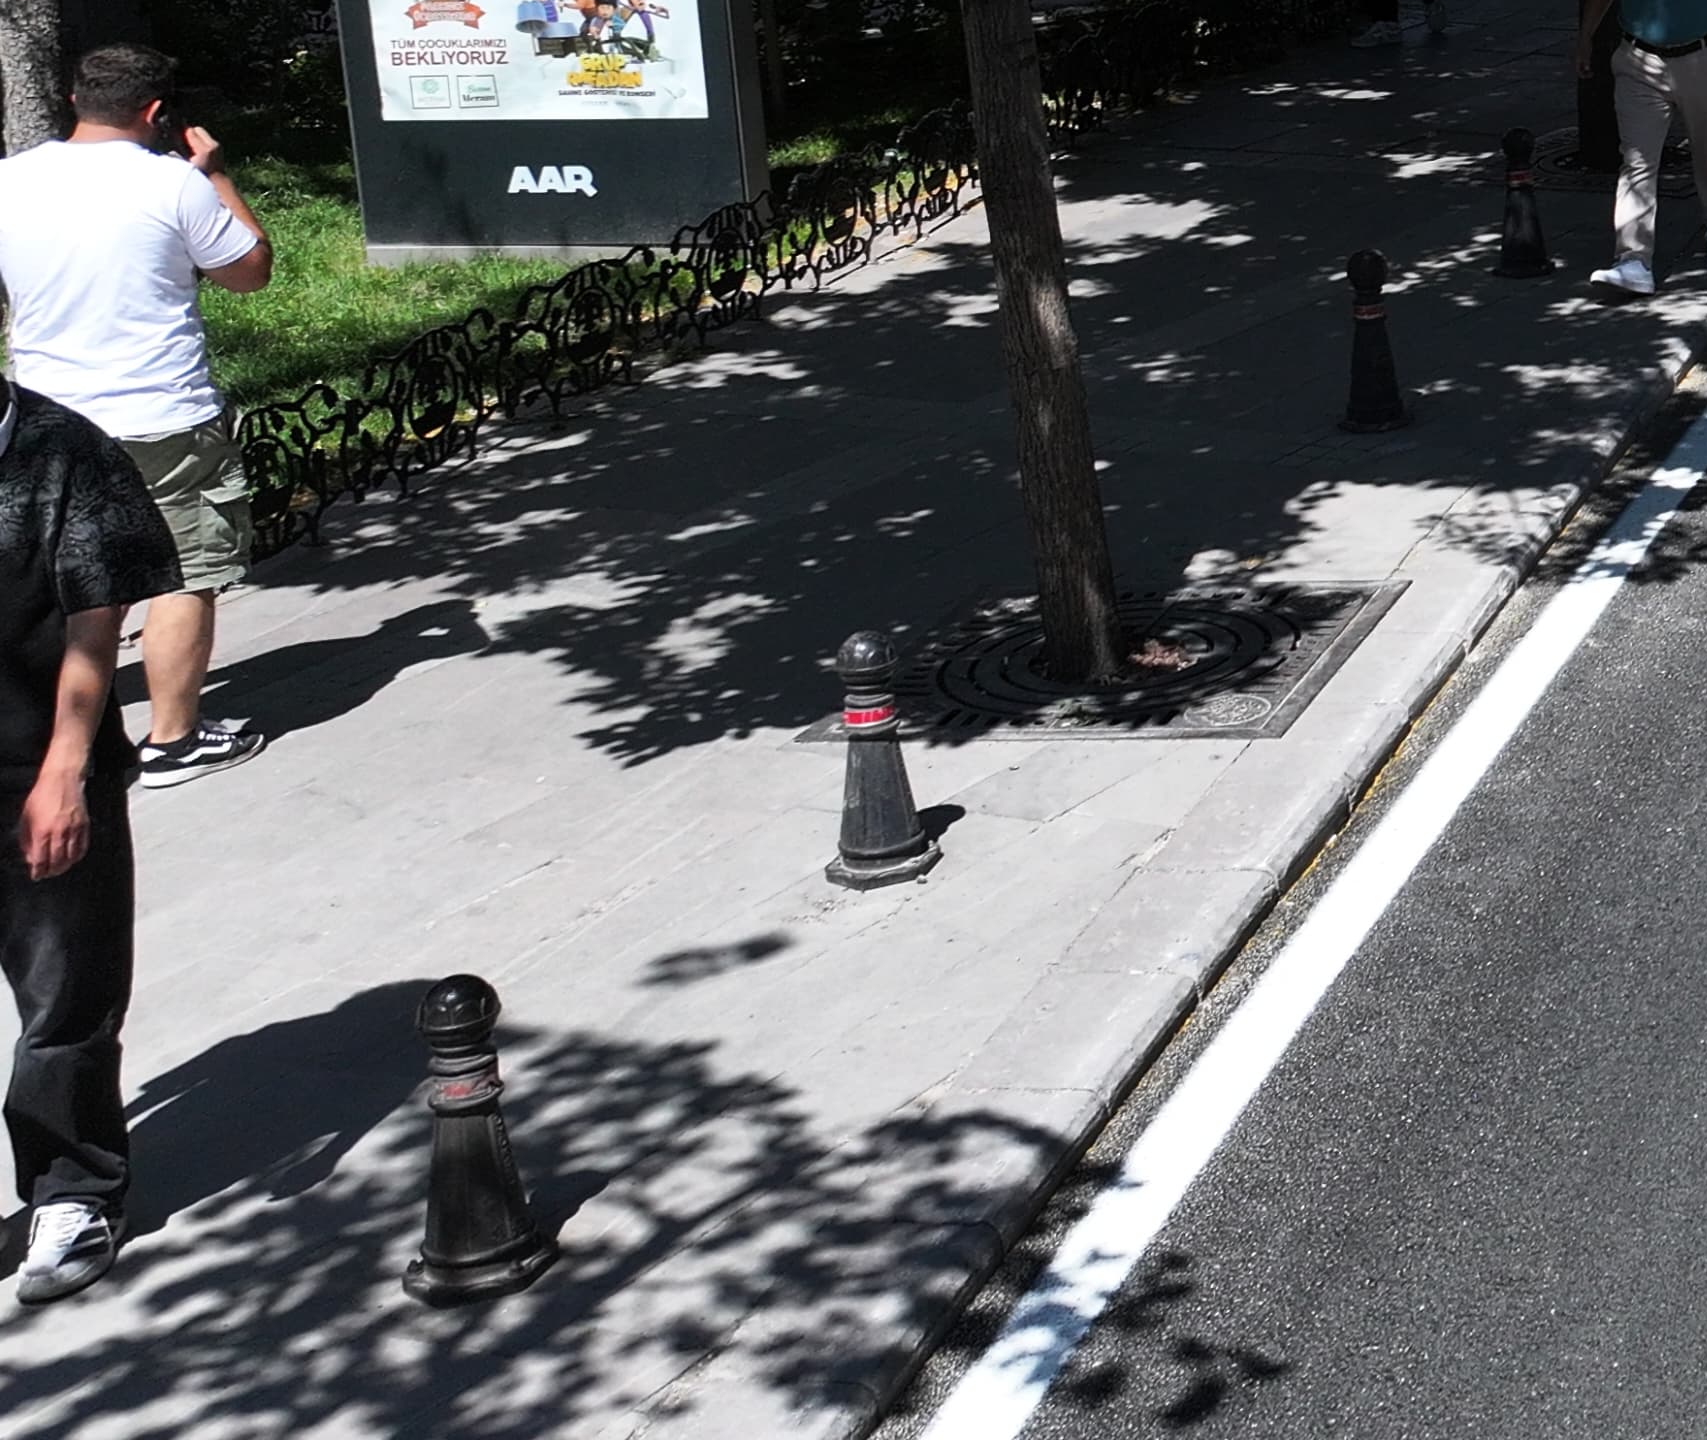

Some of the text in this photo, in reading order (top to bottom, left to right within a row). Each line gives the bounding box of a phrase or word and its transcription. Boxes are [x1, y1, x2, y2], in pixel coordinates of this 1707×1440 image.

[391, 39, 507, 51] TÜM ÇOCUKLARIMIZI
[507, 165, 598, 198] AAR
